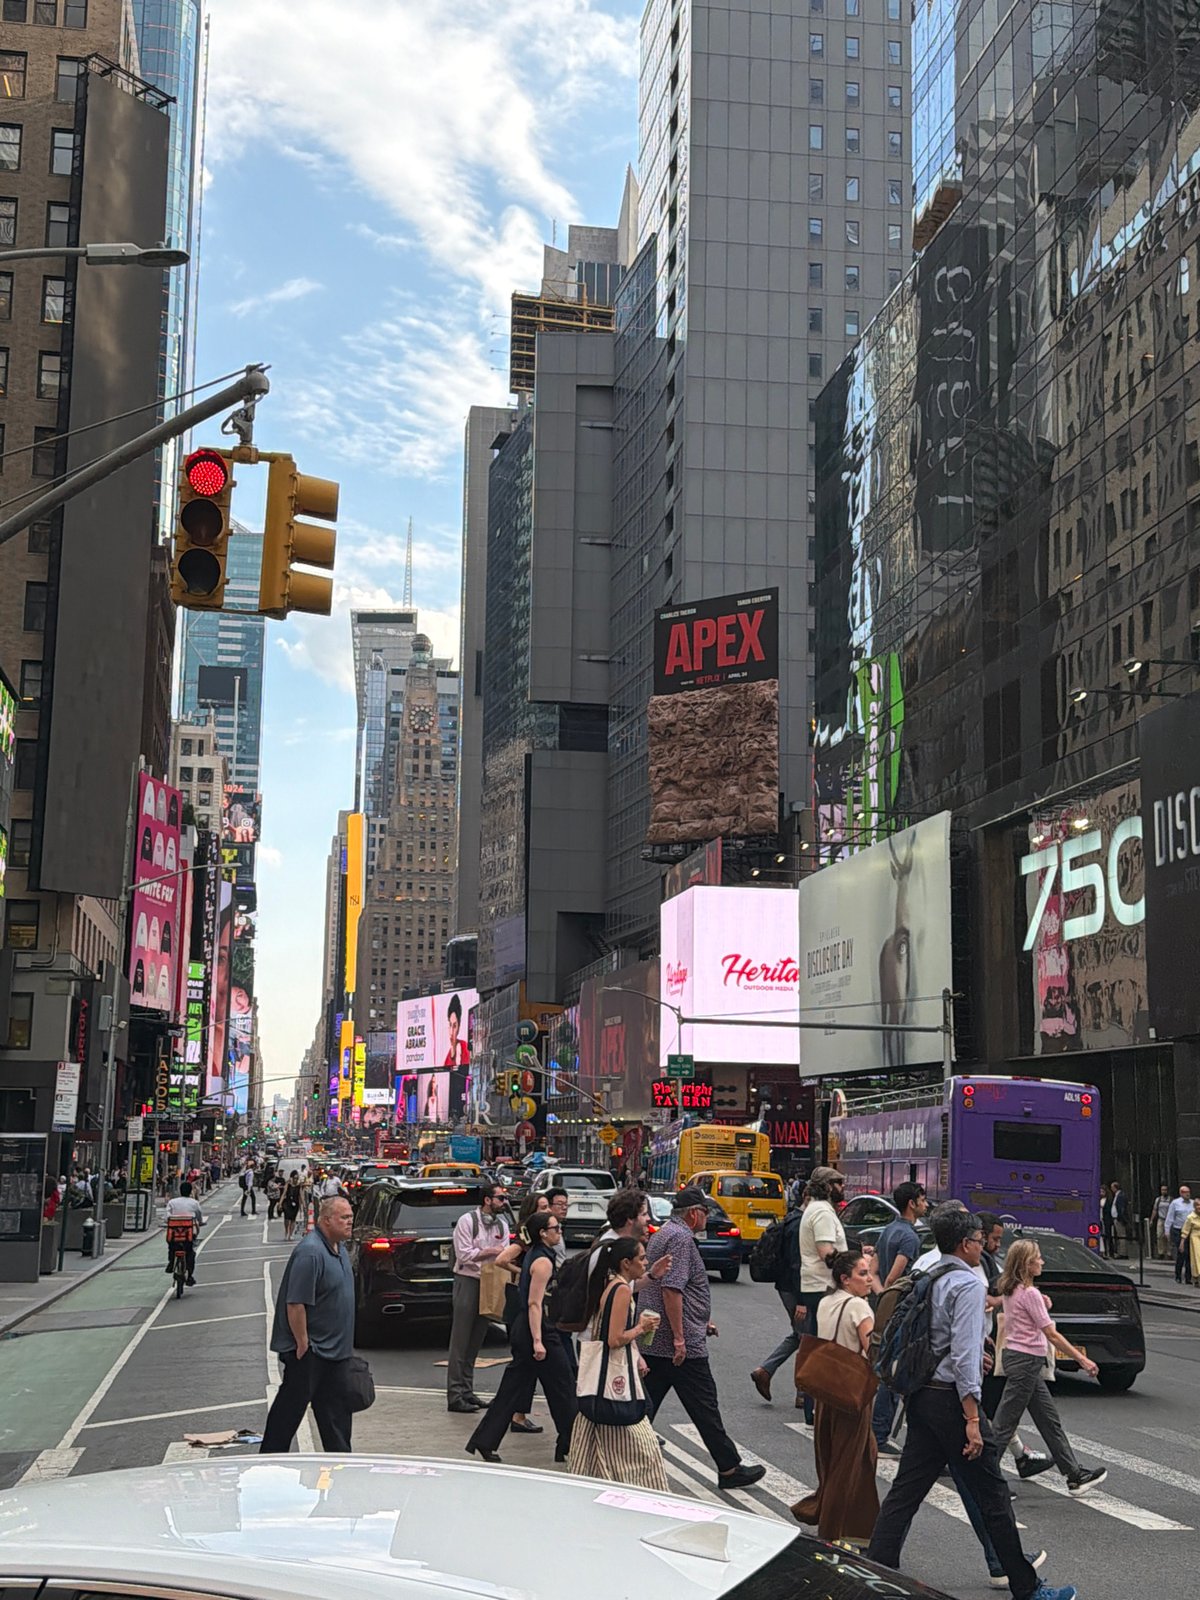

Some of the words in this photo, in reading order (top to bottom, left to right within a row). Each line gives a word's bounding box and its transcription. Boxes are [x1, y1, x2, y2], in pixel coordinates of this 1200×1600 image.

[665, 610, 765, 675] APEX
[807, 942, 841, 979] DISCLOSURE
[842, 937, 854, 969] DAY
[405, 1038, 426, 1049] ABRAMS
[407, 1025, 425, 1037] GRACIE
[156, 1037, 169, 1111] LAGOS
[885, 1125, 893, 1150] all
[895, 1123, 914, 1149] ranked
